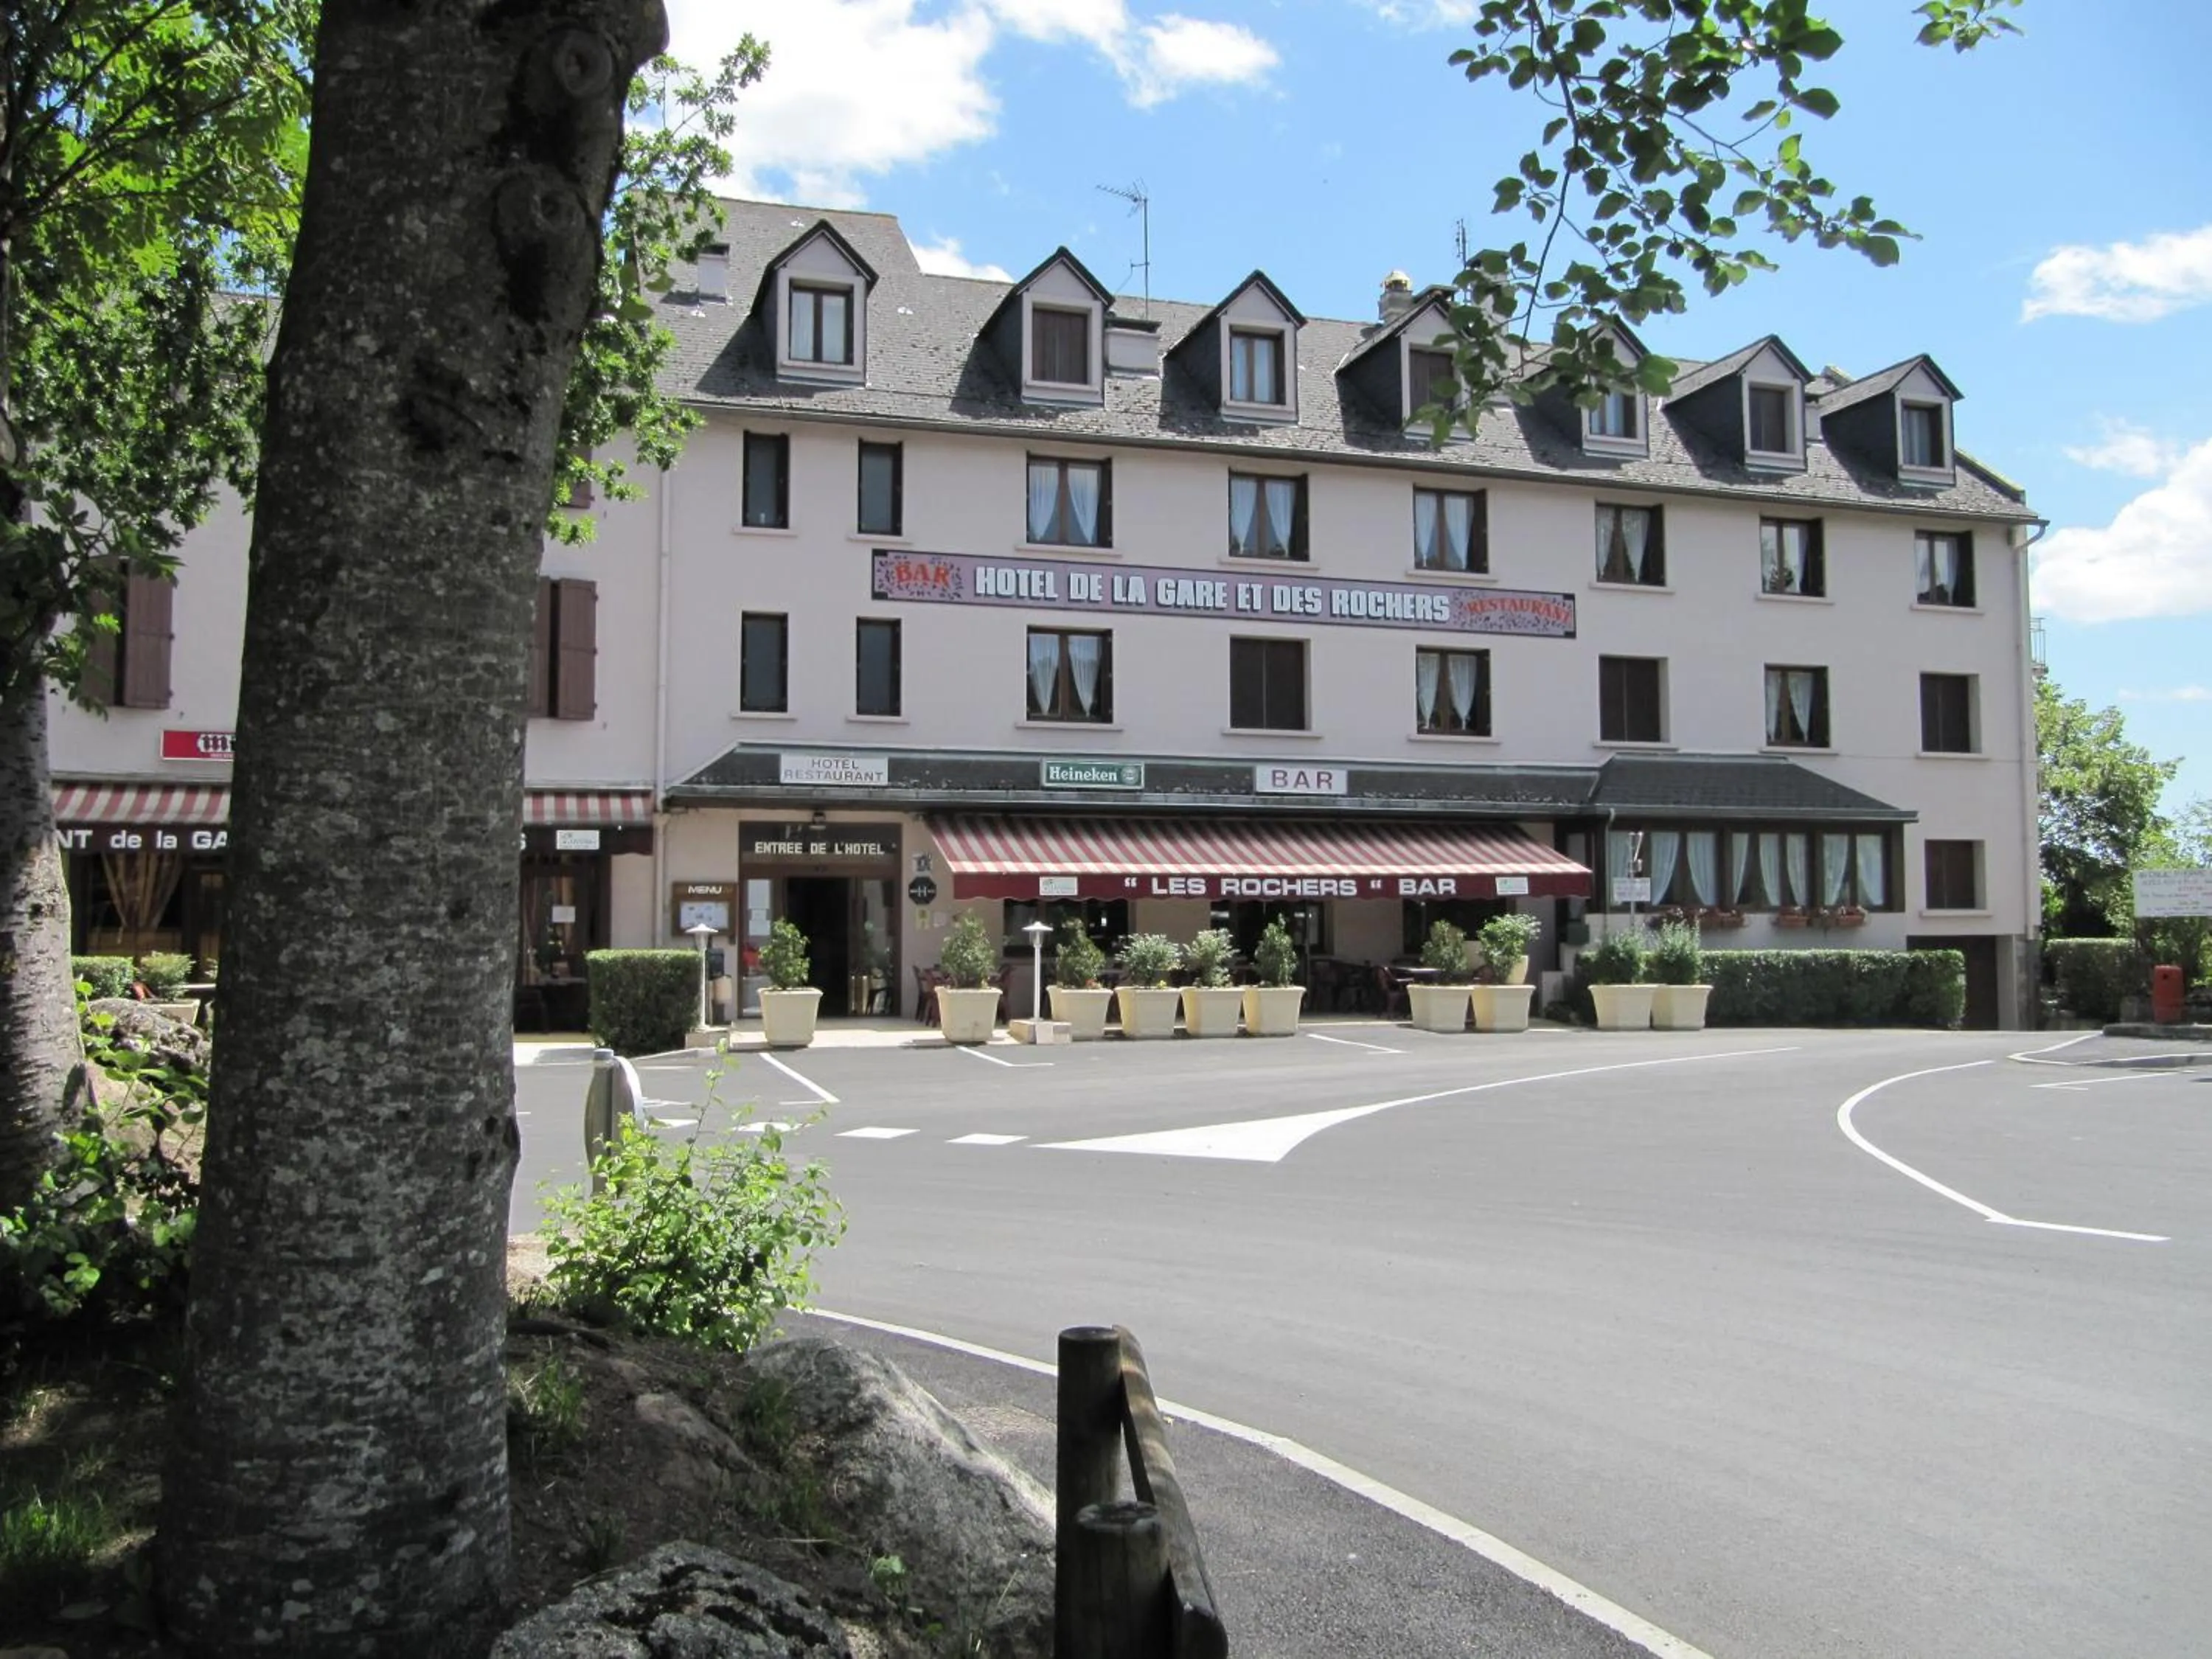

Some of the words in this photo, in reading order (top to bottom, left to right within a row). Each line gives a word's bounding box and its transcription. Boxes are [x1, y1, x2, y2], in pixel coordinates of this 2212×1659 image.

[895, 561, 950, 588] BAR
[975, 566, 1058, 599] HOTEL
[1070, 572, 1103, 602] DE
[1114, 575, 1147, 605] LA
[1157, 577, 1228, 610] GARE
[1237, 582, 1263, 611] ET
[1273, 585, 1322, 615] DES
[1331, 589, 1450, 622] ROCHERS
[1466, 598, 1571, 624] RESTAURANT
[811, 758, 859, 771] HOTEL
[1049, 766, 1117, 782] Heineken
[783, 769, 884, 782] RESTAURANT
[1271, 769, 1333, 790] BAR
[110, 830, 142, 849] de
[156, 830, 178, 849] la
[755, 841, 802, 855] ENTREE
[810, 842, 827, 855] DE
[835, 842, 885, 855] L'HOTEL
[688, 886, 722, 894] MENU
[1152, 877, 1206, 894] LES
[1221, 878, 1357, 896] ROCHERS
[1399, 878, 1456, 895] BAR
